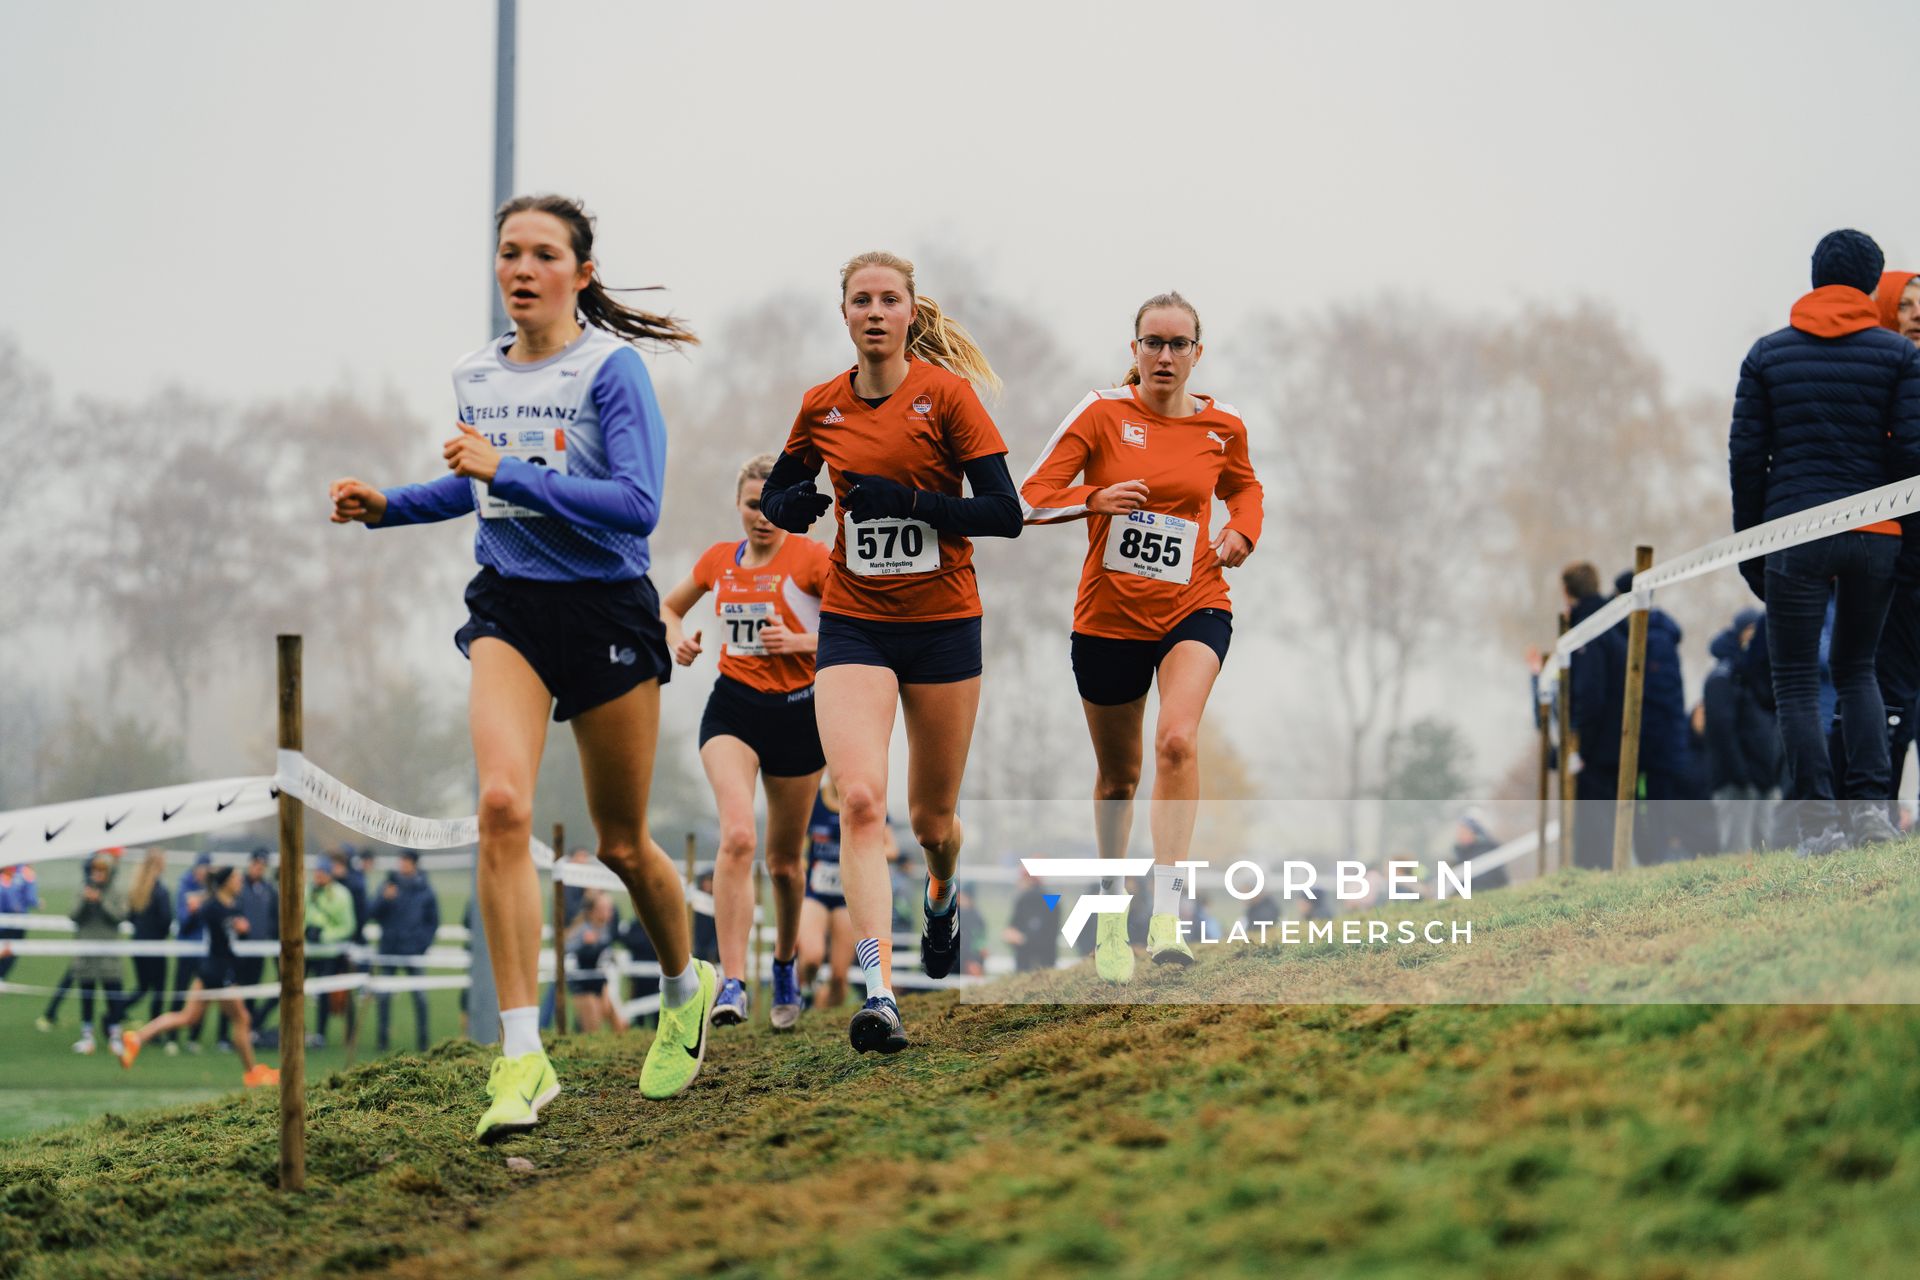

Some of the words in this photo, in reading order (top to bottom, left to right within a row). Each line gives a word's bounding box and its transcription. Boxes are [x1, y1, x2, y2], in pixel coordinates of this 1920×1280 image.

[476, 406, 509, 420] TELIS
[516, 405, 577, 422] FINANZ
[483, 432, 508, 447] LS
[1128, 511, 1156, 525] GLS
[857, 524, 923, 560] 570
[1119, 527, 1182, 567] 855
[725, 604, 743, 613] GLS
